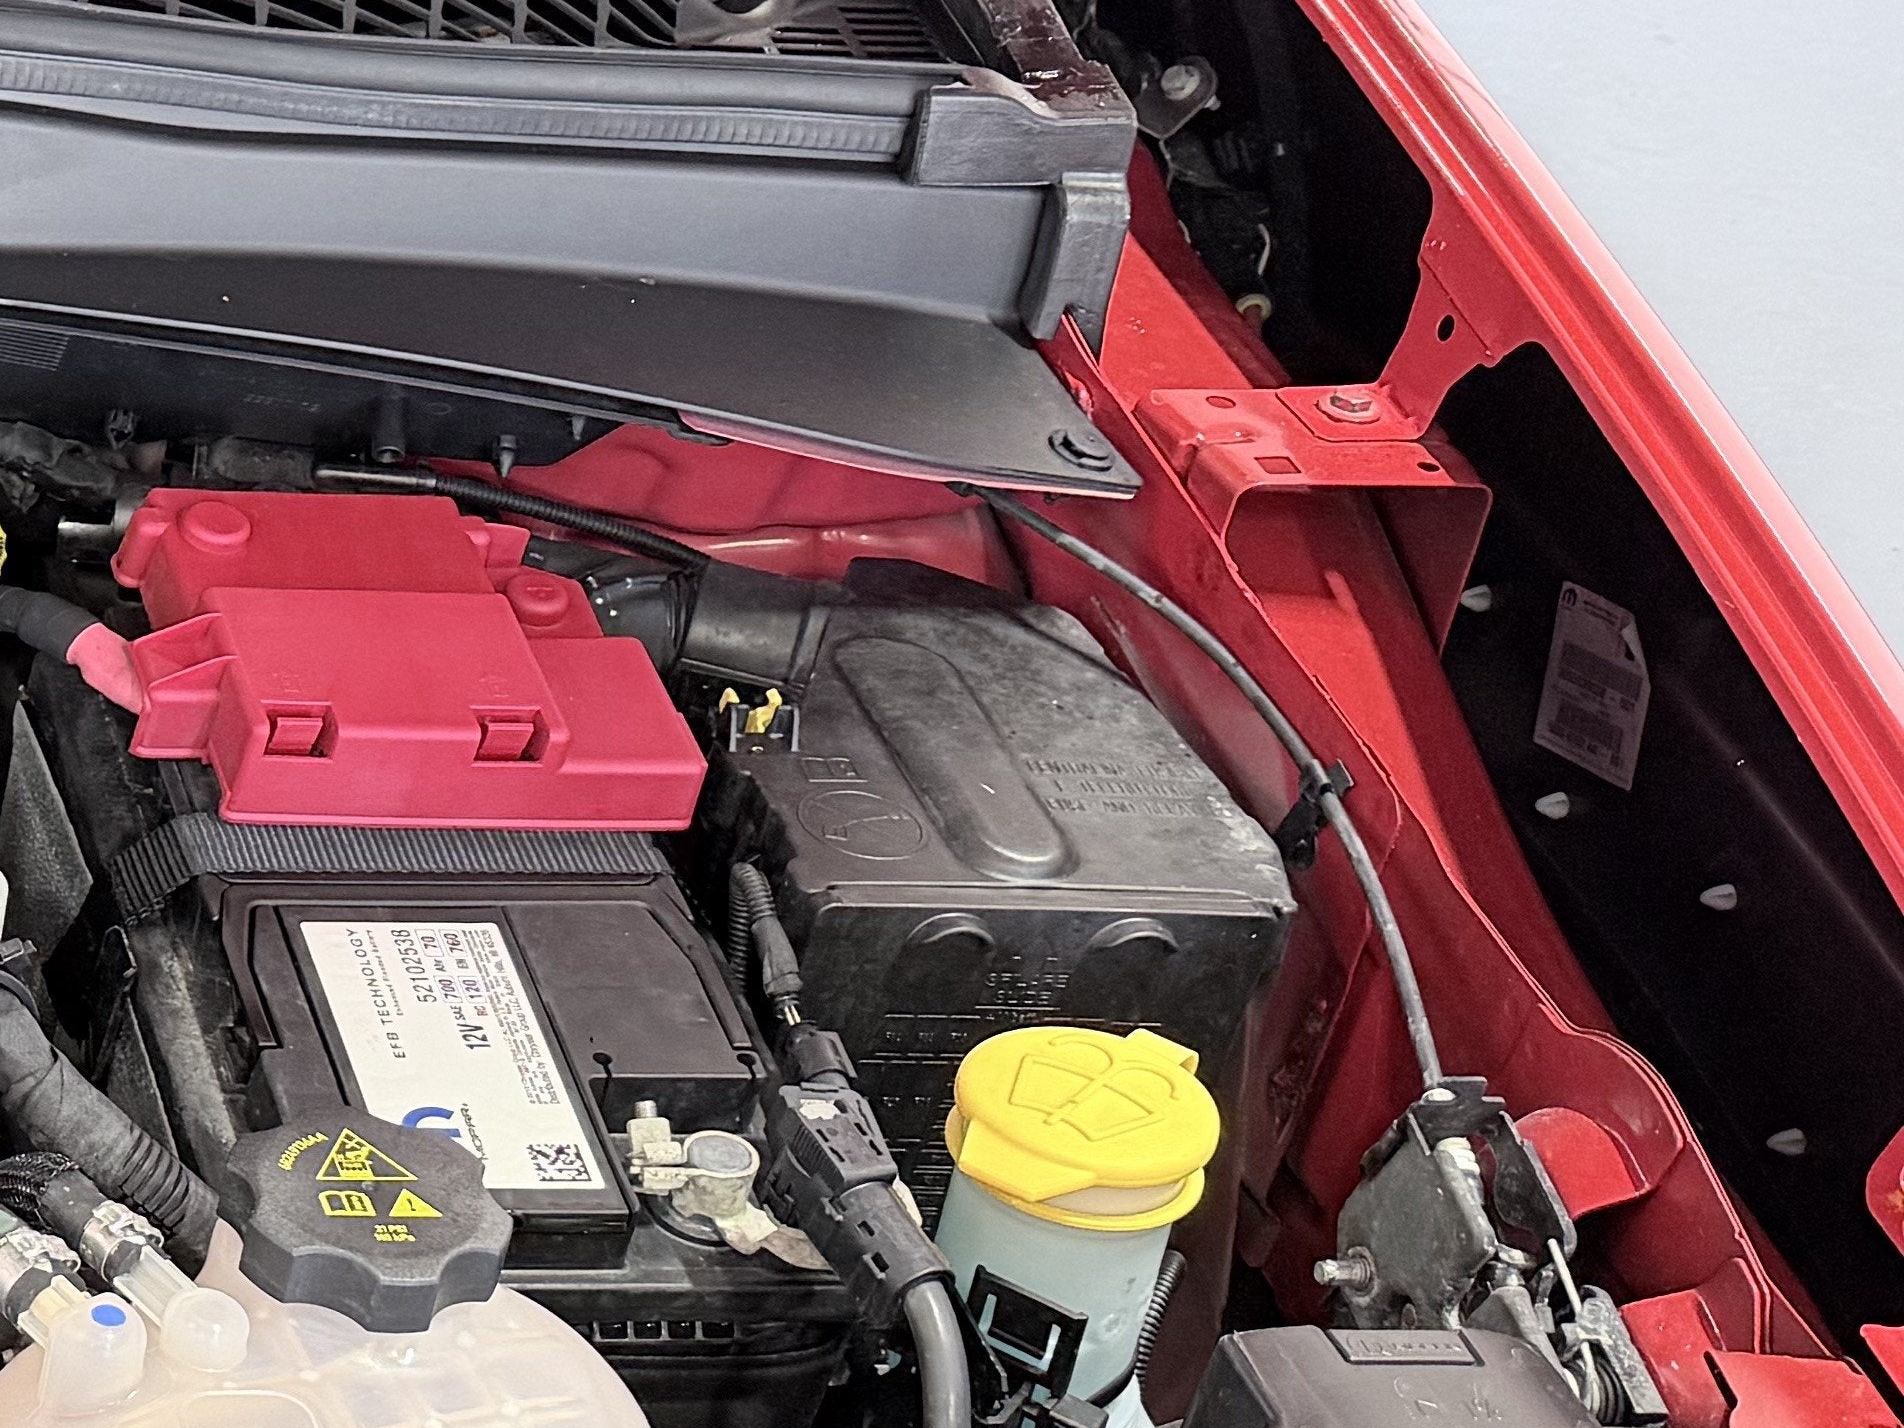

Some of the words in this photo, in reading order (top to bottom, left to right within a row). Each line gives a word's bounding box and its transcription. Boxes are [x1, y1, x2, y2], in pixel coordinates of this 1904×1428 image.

[420, 935, 437, 950] 70
[444, 932, 463, 953] 760
[345, 927, 395, 1026] TECHNOLOGY
[390, 928, 438, 1004] 52102538
[438, 978, 456, 1000] 700
[462, 979, 482, 1000] 120
[450, 1004, 468, 1021] SAE
[387, 1031, 408, 1059] EFB
[457, 1023, 492, 1050] 12V
